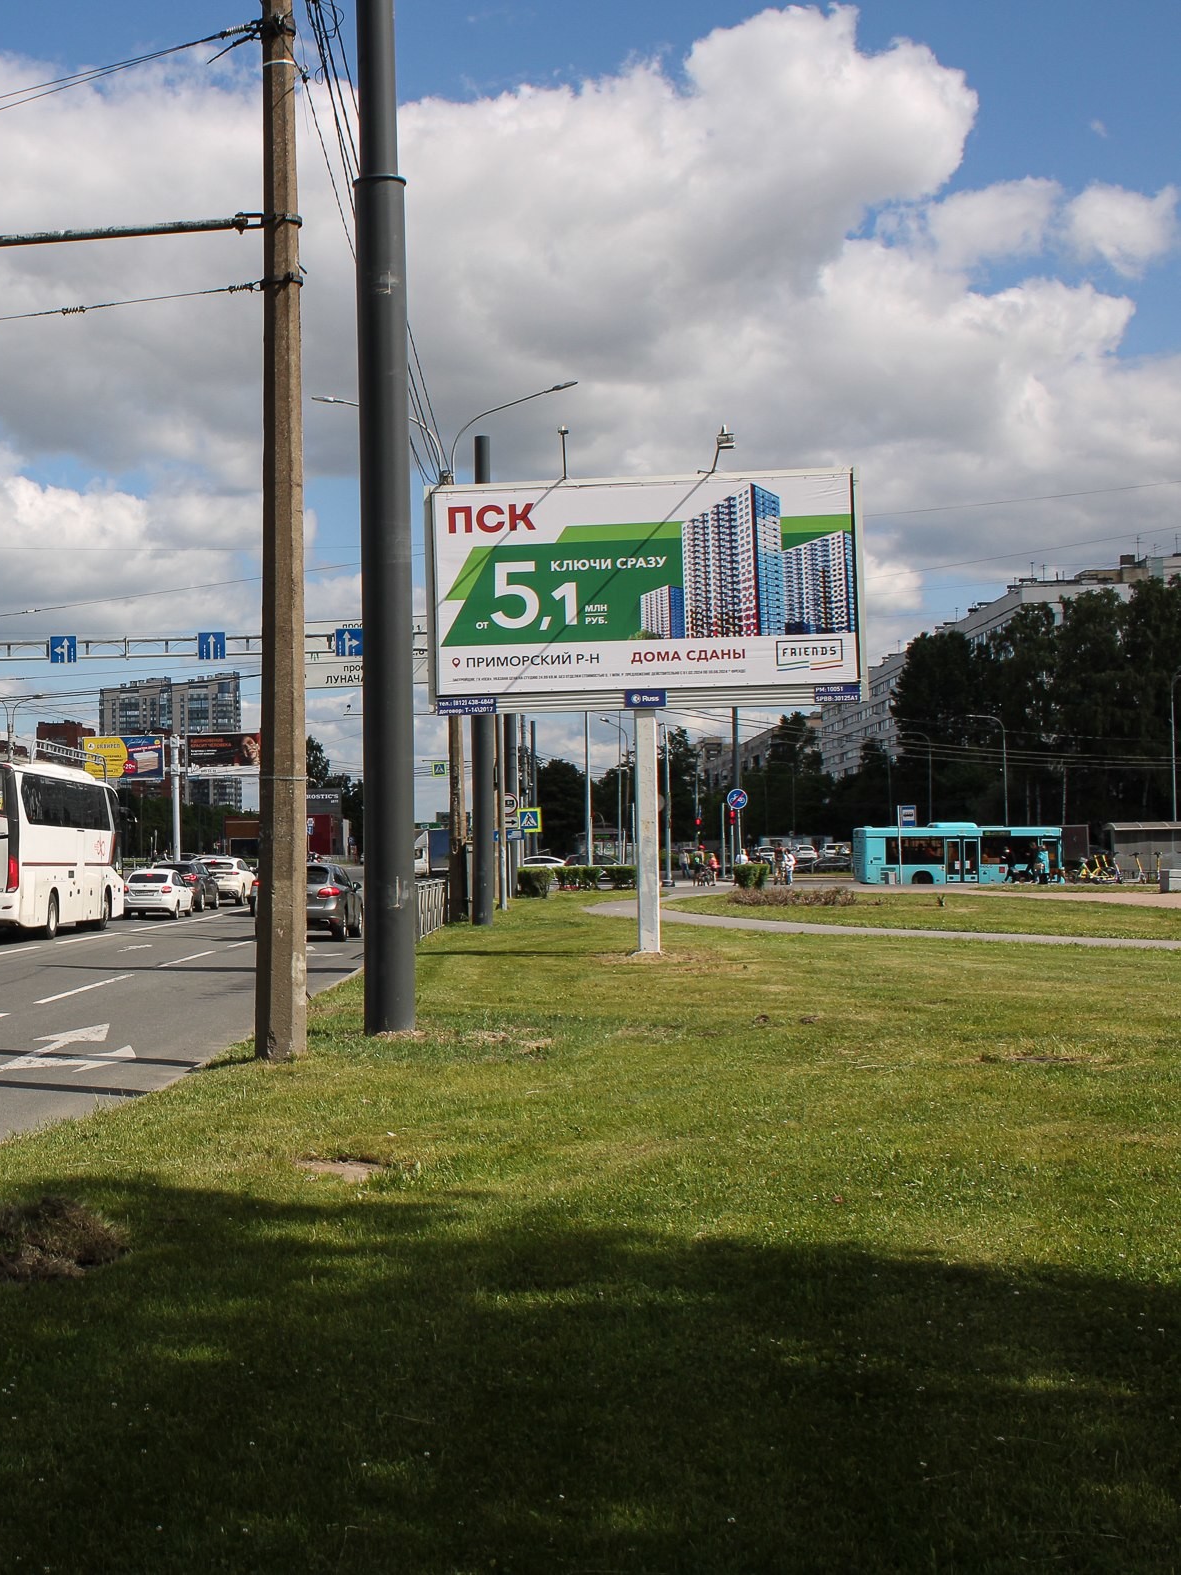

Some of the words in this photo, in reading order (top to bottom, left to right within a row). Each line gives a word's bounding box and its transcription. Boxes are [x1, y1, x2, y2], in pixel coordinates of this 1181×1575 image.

[447, 503, 536, 534] ПСК
[550, 558, 612, 572] КЛЮЧИ
[616, 556, 667, 570] СРАЗУ
[490, 560, 578, 631] 5,1
[585, 604, 607, 613] МЛН
[585, 616, 608, 625] РУБ.
[466, 652, 572, 668] ПРИМОРСКИЙ
[576, 653, 600, 664] Р-Н
[631, 650, 682, 664] ДОМА
[686, 649, 746, 662] СДАНЫ
[325, 674, 363, 684] ЛУНАЧ
